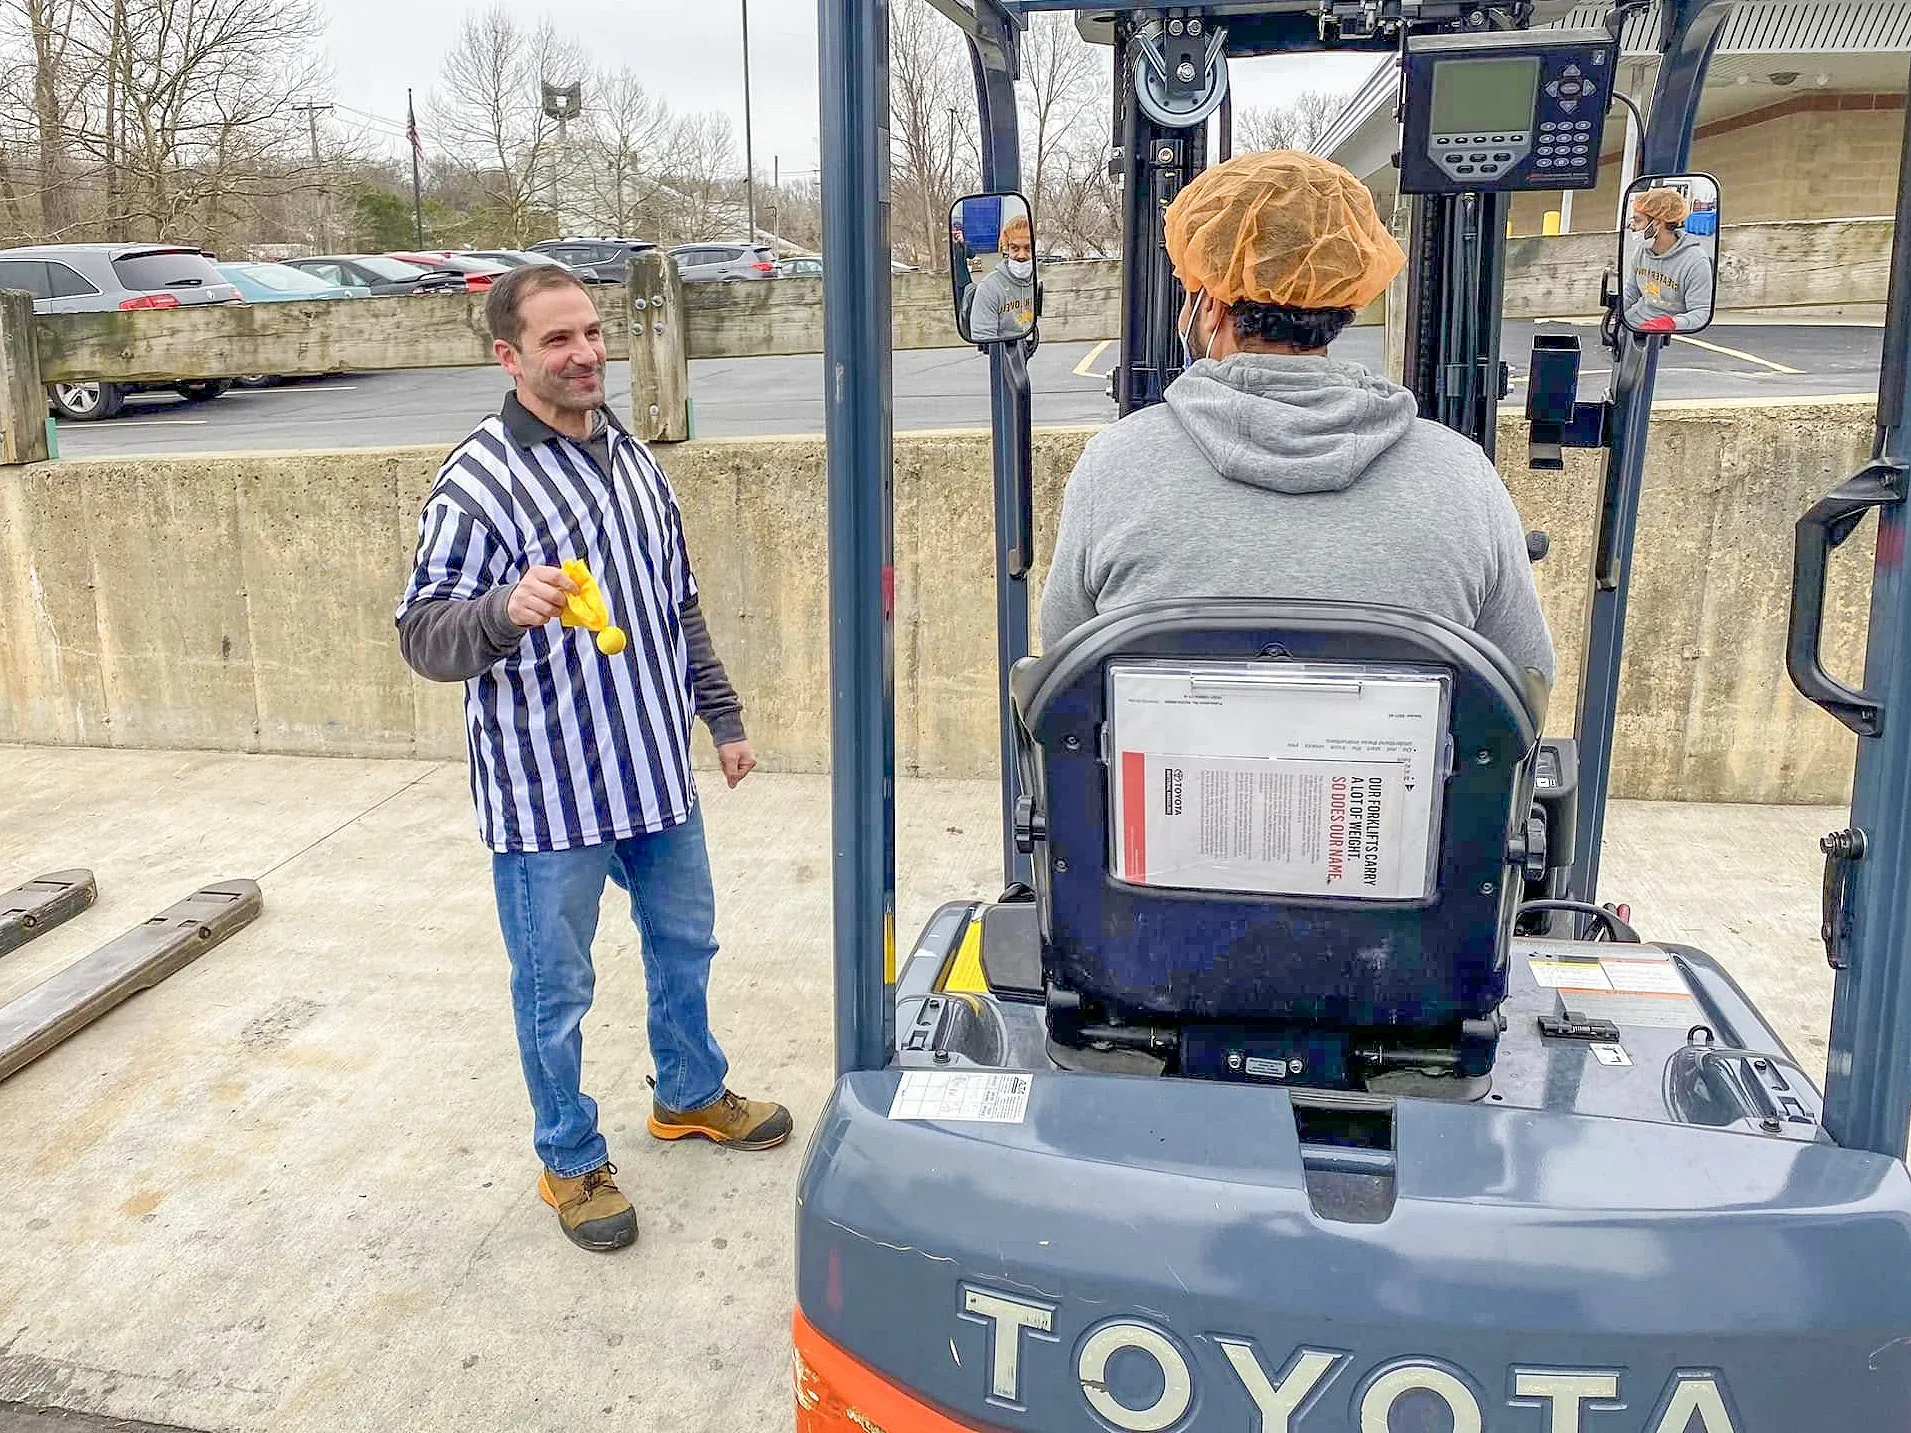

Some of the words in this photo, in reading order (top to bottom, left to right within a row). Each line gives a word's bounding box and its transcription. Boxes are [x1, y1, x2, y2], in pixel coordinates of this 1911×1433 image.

[1332, 776, 1347, 790] SO
[1350, 786, 1363, 805] LOT
[1368, 777, 1382, 797] OUR
[1174, 783, 1182, 816] TOYOTA
[1330, 793, 1346, 822] DOES
[1349, 807, 1363, 819] OF
[1330, 824, 1345, 846] OUR
[1366, 800, 1381, 852] FORKLIFTS
[1347, 821, 1362, 861] WEIGHT.
[1364, 854, 1378, 886] CARRY
[963, 1289, 1736, 1433] TOYOTA
